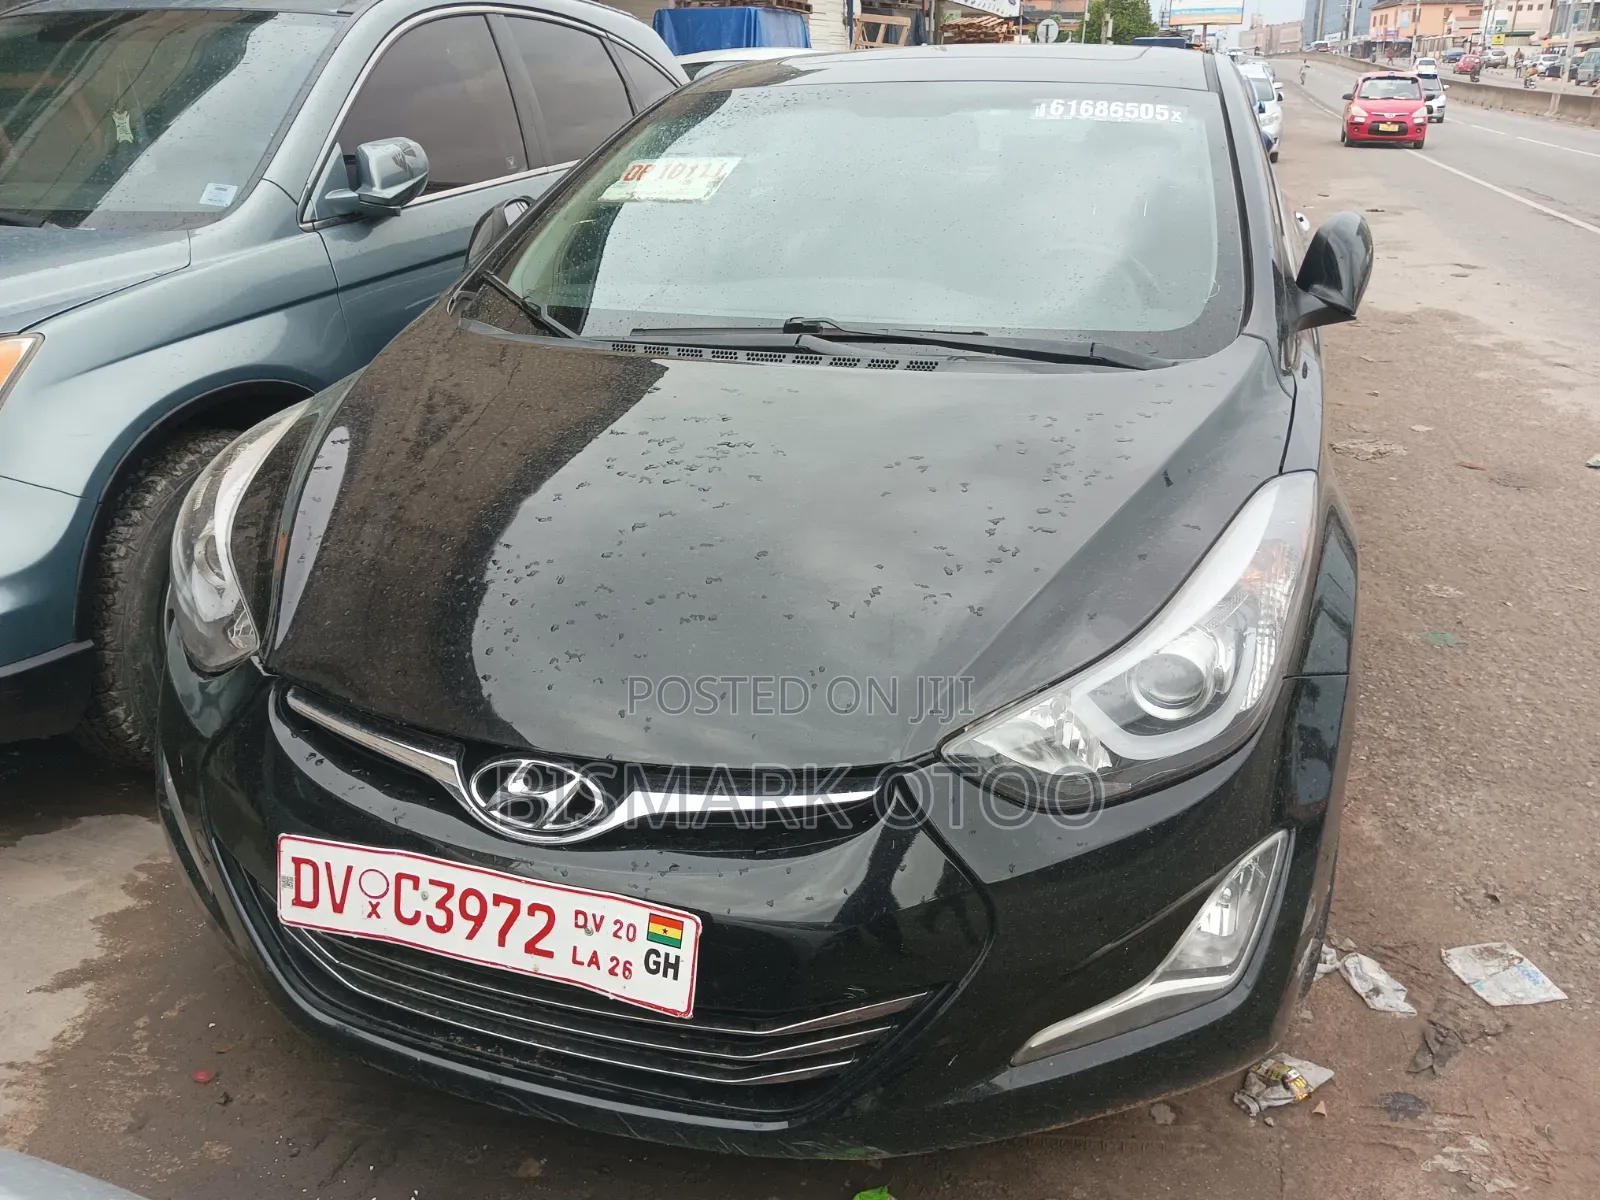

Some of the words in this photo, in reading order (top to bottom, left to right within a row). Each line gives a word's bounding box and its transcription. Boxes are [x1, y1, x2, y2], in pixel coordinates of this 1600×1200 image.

[291, 856, 354, 914] DV
[393, 872, 556, 959] C3972
[574, 909, 605, 933] DV
[612, 918, 637, 943] 20
[571, 945, 601, 971] LA
[608, 955, 633, 980] 26
[643, 947, 681, 982] GH
